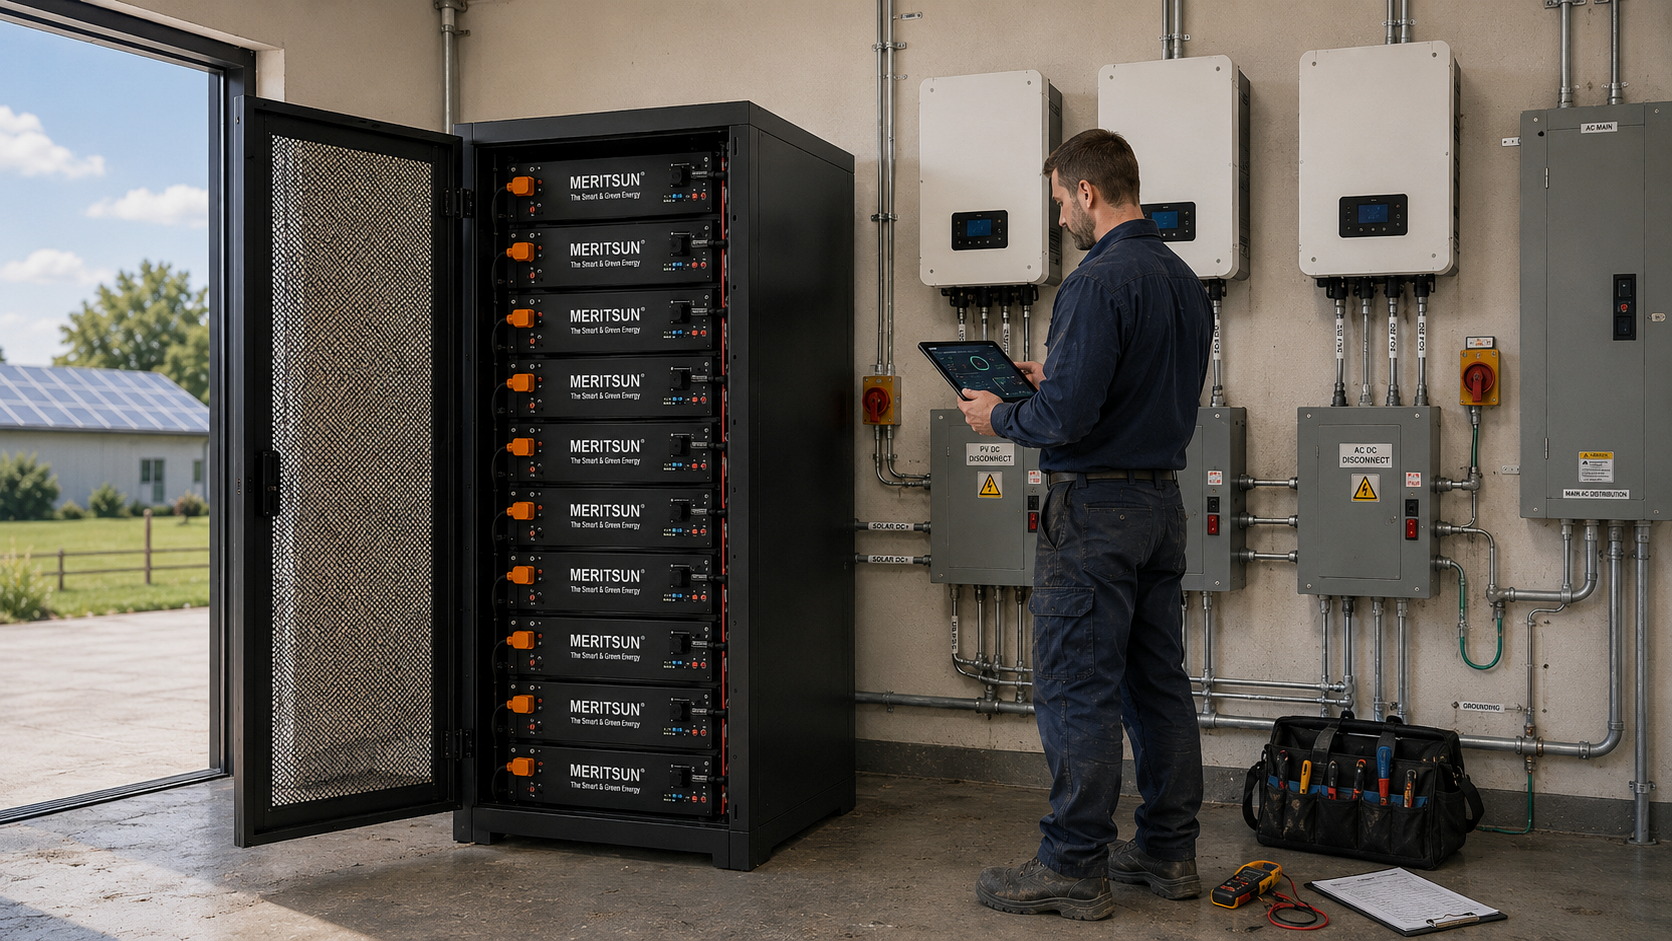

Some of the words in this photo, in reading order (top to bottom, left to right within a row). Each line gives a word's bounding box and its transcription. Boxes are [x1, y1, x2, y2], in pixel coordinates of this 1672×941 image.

[621, 191, 640, 199] Energy
[621, 259, 640, 267] Energy
[621, 326, 640, 334] Energy
[621, 392, 640, 400] Energy
[621, 457, 640, 465] Energy
[621, 522, 640, 530] Energy
[621, 587, 640, 595] Energy
[621, 653, 640, 662] Energy
[621, 720, 640, 728] Energy
[621, 785, 640, 794] Energy
